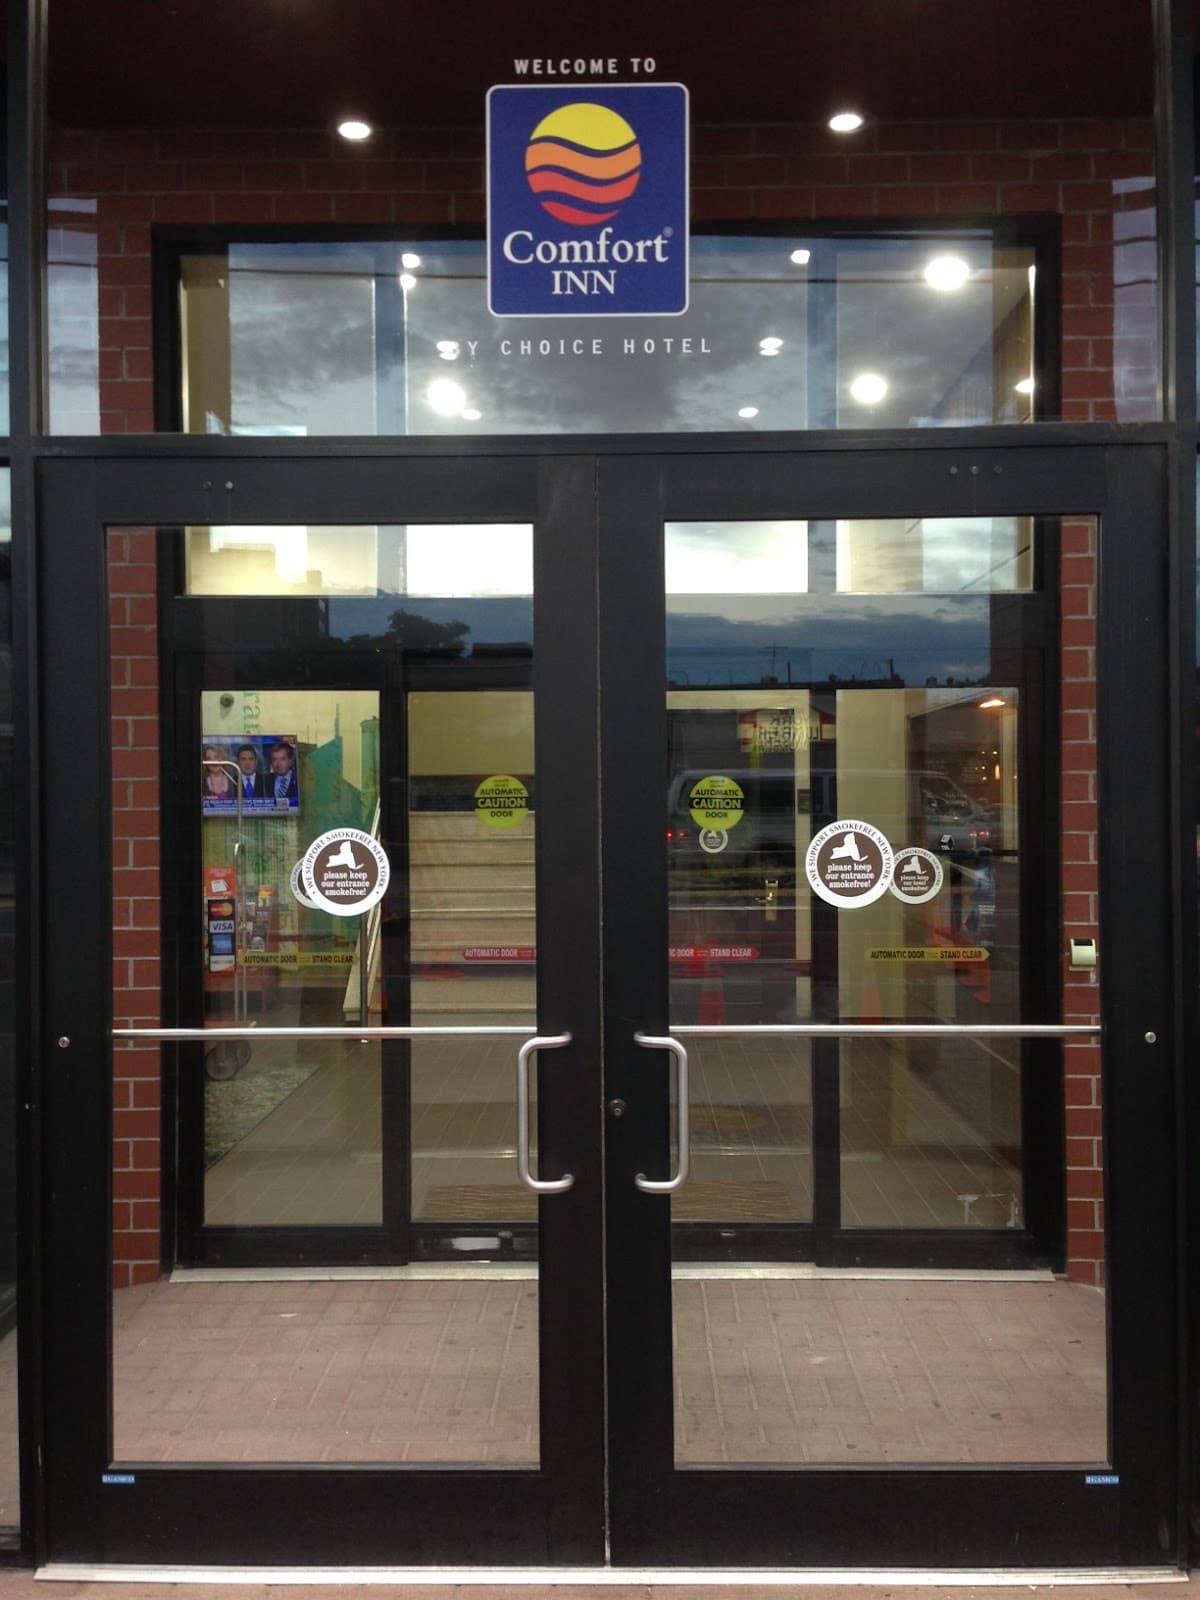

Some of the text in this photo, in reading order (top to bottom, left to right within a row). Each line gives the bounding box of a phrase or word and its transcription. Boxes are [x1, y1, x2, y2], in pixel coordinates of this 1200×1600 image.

[514, 58, 656, 74] WELCOME TO
[503, 227, 669, 264] Comfort
[551, 270, 617, 294] INN
[501, 339, 603, 355] CHOICE
[623, 338, 712, 354] HOTEL
[477, 798, 526, 808] CAUTION
[692, 799, 741, 809] CAUTION
[829, 823, 876, 836] SMOKEFREE
[809, 831, 828, 866] SUPPORT
[877, 836, 889, 855] NEW
[305, 831, 388, 889] WE SUPPORT SMOKEFREE NEW YORK
[827, 863, 872, 872] please keep
[883, 853, 892, 879] YORK
[323, 871, 368, 881] please keep
[809, 869, 817, 882] WE
[841, 872, 875, 880] entrance
[829, 880, 871, 888] smokefree!
[325, 887, 367, 896] smokefree!
[213, 923, 233, 931] VISA
[464, 948, 518, 957] AUTOMATIC DOOR
[677, 948, 695, 957] DOOR
[710, 948, 730, 957] STAND
[731, 948, 752, 957] CLEAR
[871, 951, 982, 959] AUTOMATIC DOOR STAND CLEAR
[244, 955, 353, 963] AUTOMATIC DOOR STAND CLEAR
